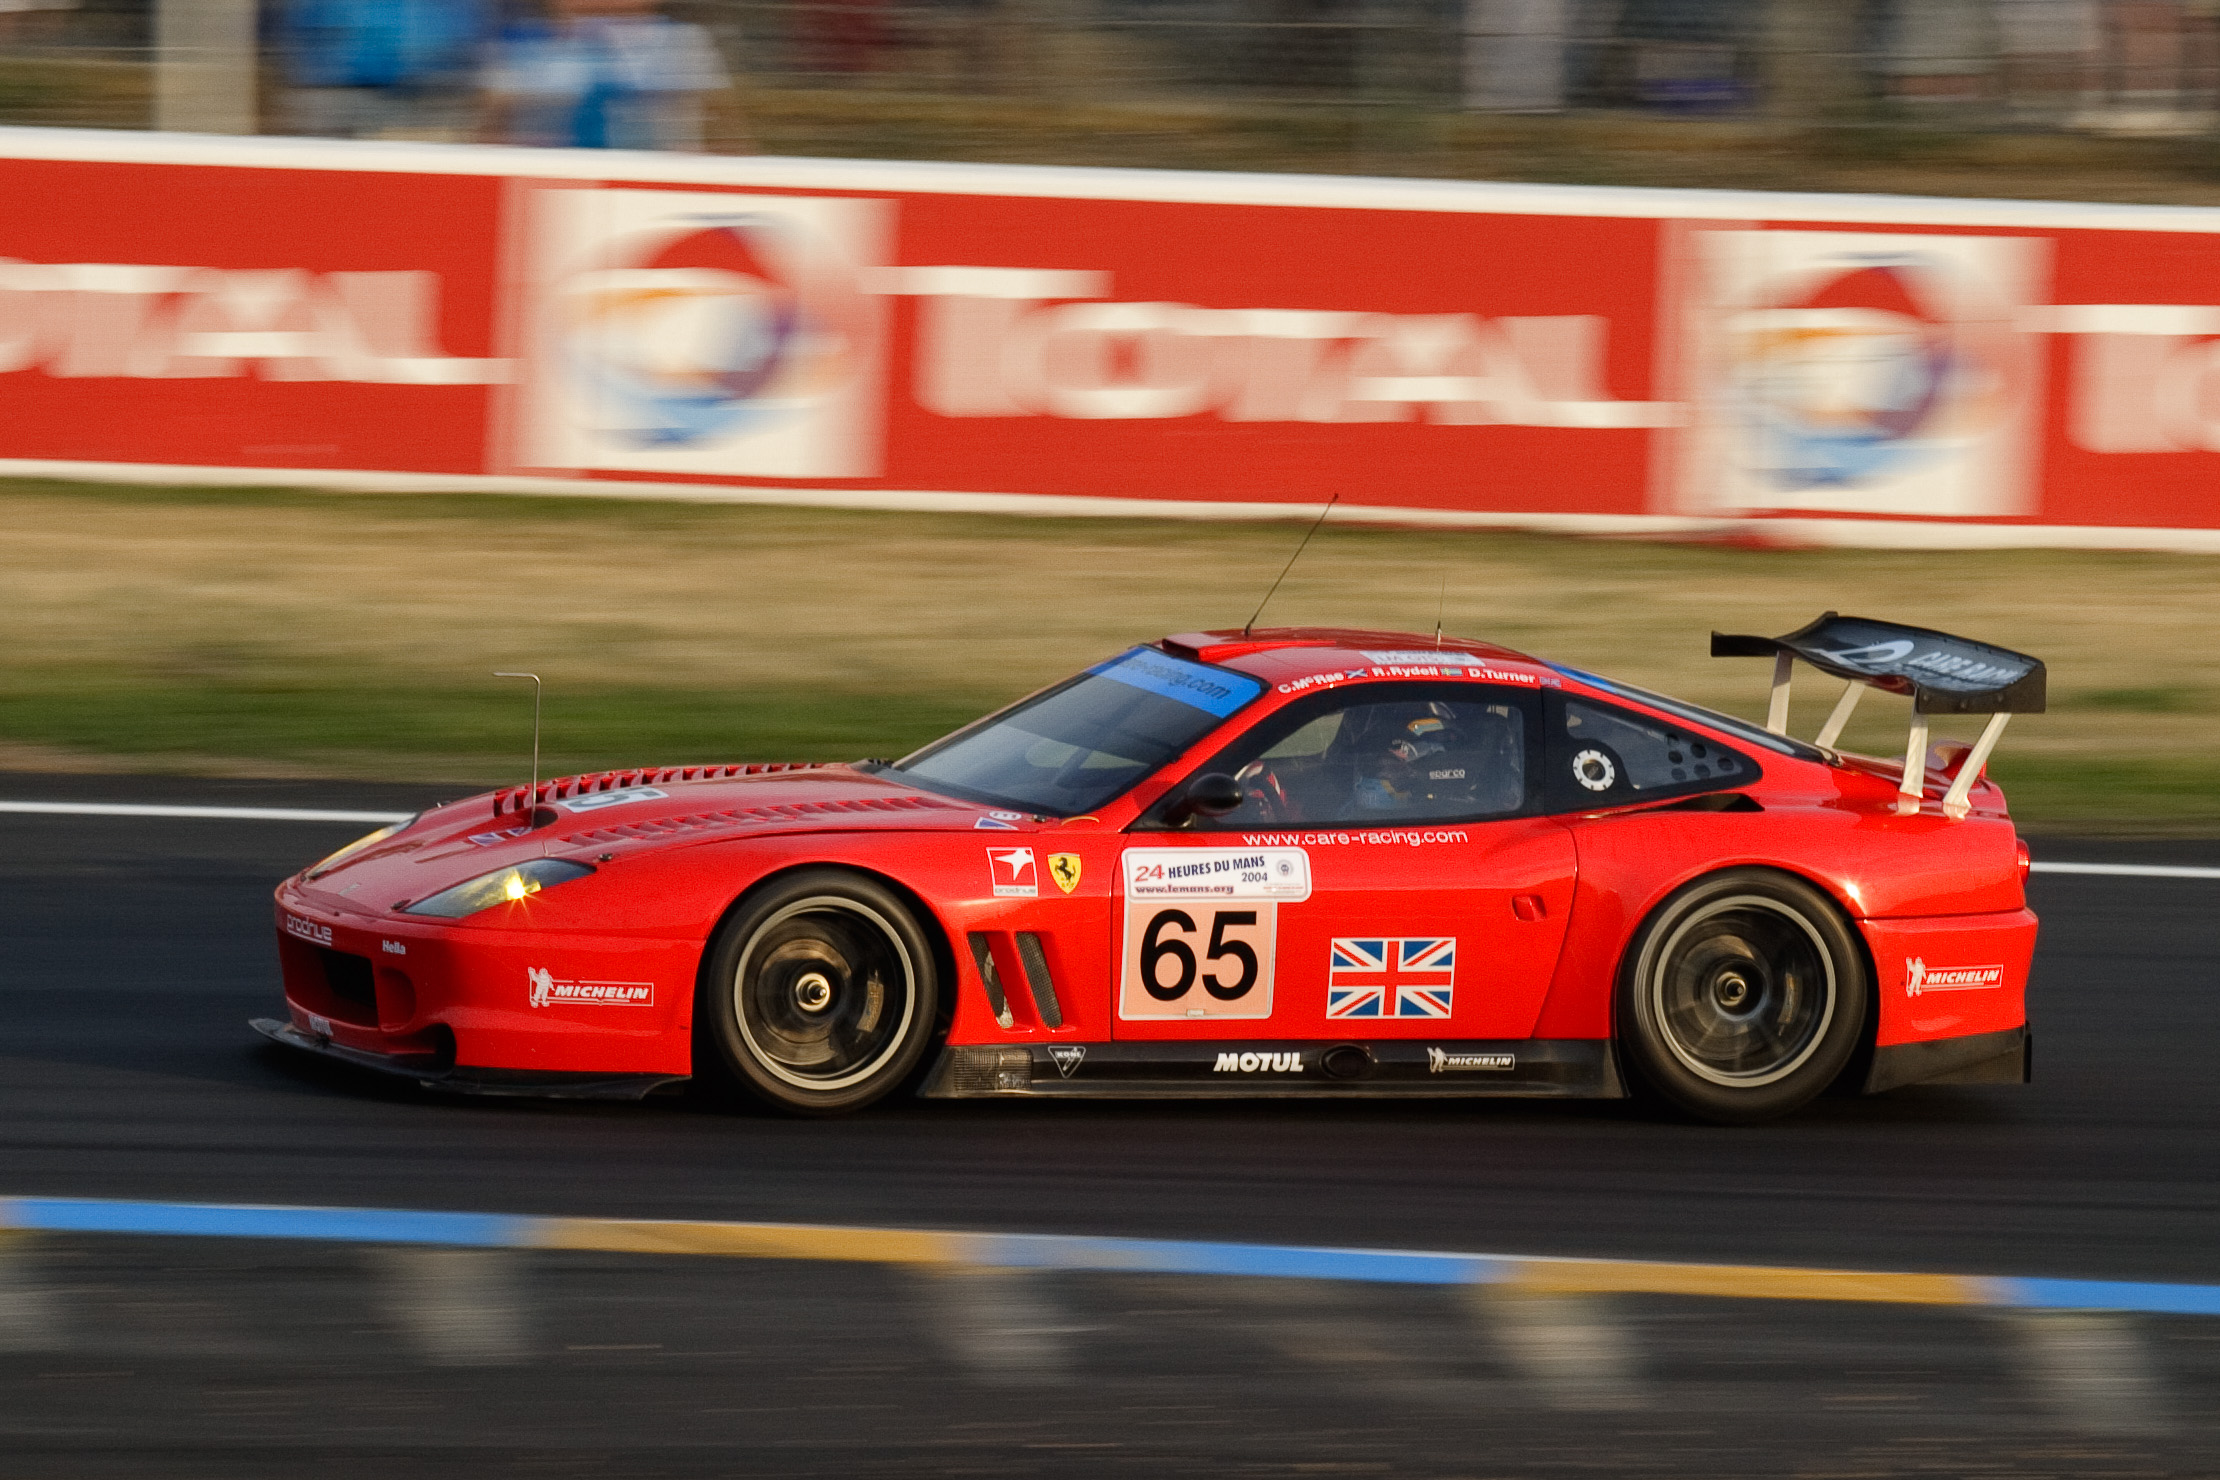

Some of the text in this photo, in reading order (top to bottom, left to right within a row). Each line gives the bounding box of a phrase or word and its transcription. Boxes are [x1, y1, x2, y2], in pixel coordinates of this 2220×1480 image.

[862, 265, 1686, 428] TOTAL
[1468, 668, 1535, 683] D.Turner
[1243, 830, 1468, 846] www.care-racing.com
[1134, 855, 1266, 882] 24 HEURES DU MANS
[1241, 872, 1268, 882] 2004
[1135, 884, 1235, 895] www.lemans.org
[382, 940, 406, 955] Hella
[1140, 908, 1259, 1002] 65
[1926, 969, 2000, 984] MICHELIN
[555, 985, 649, 999] MICHELIN
[1213, 1052, 1304, 1072] MOTUL
[1448, 1057, 1512, 1066] MICHELIN
